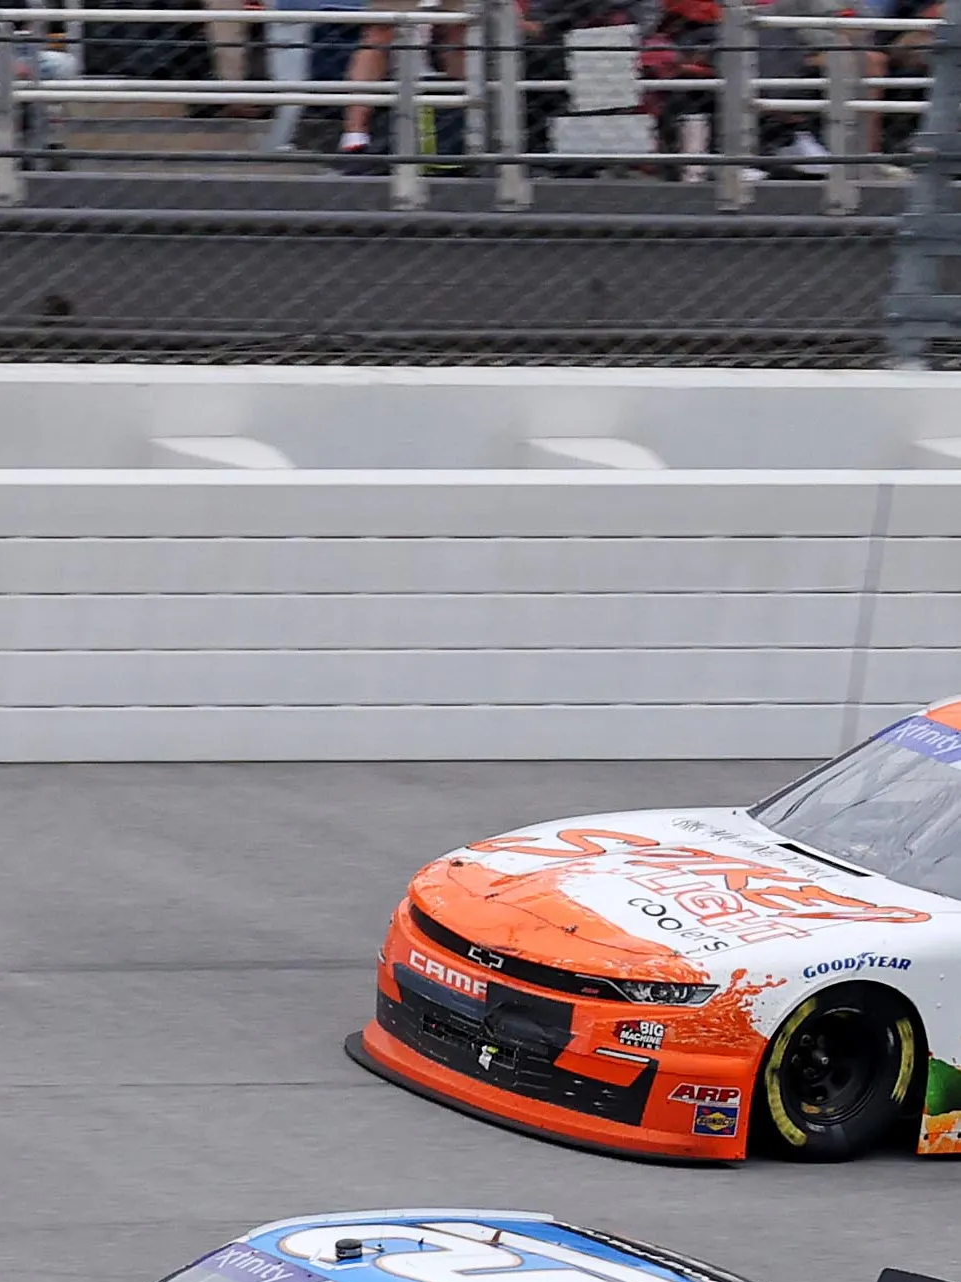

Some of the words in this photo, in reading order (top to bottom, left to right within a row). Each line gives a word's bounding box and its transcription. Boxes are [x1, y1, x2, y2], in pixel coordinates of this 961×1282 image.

[626, 868, 812, 944] LIGHT
[620, 1030, 662, 1045] MACHINE
[640, 1021, 664, 1037] BIG
[670, 1085, 740, 1104] ARP
